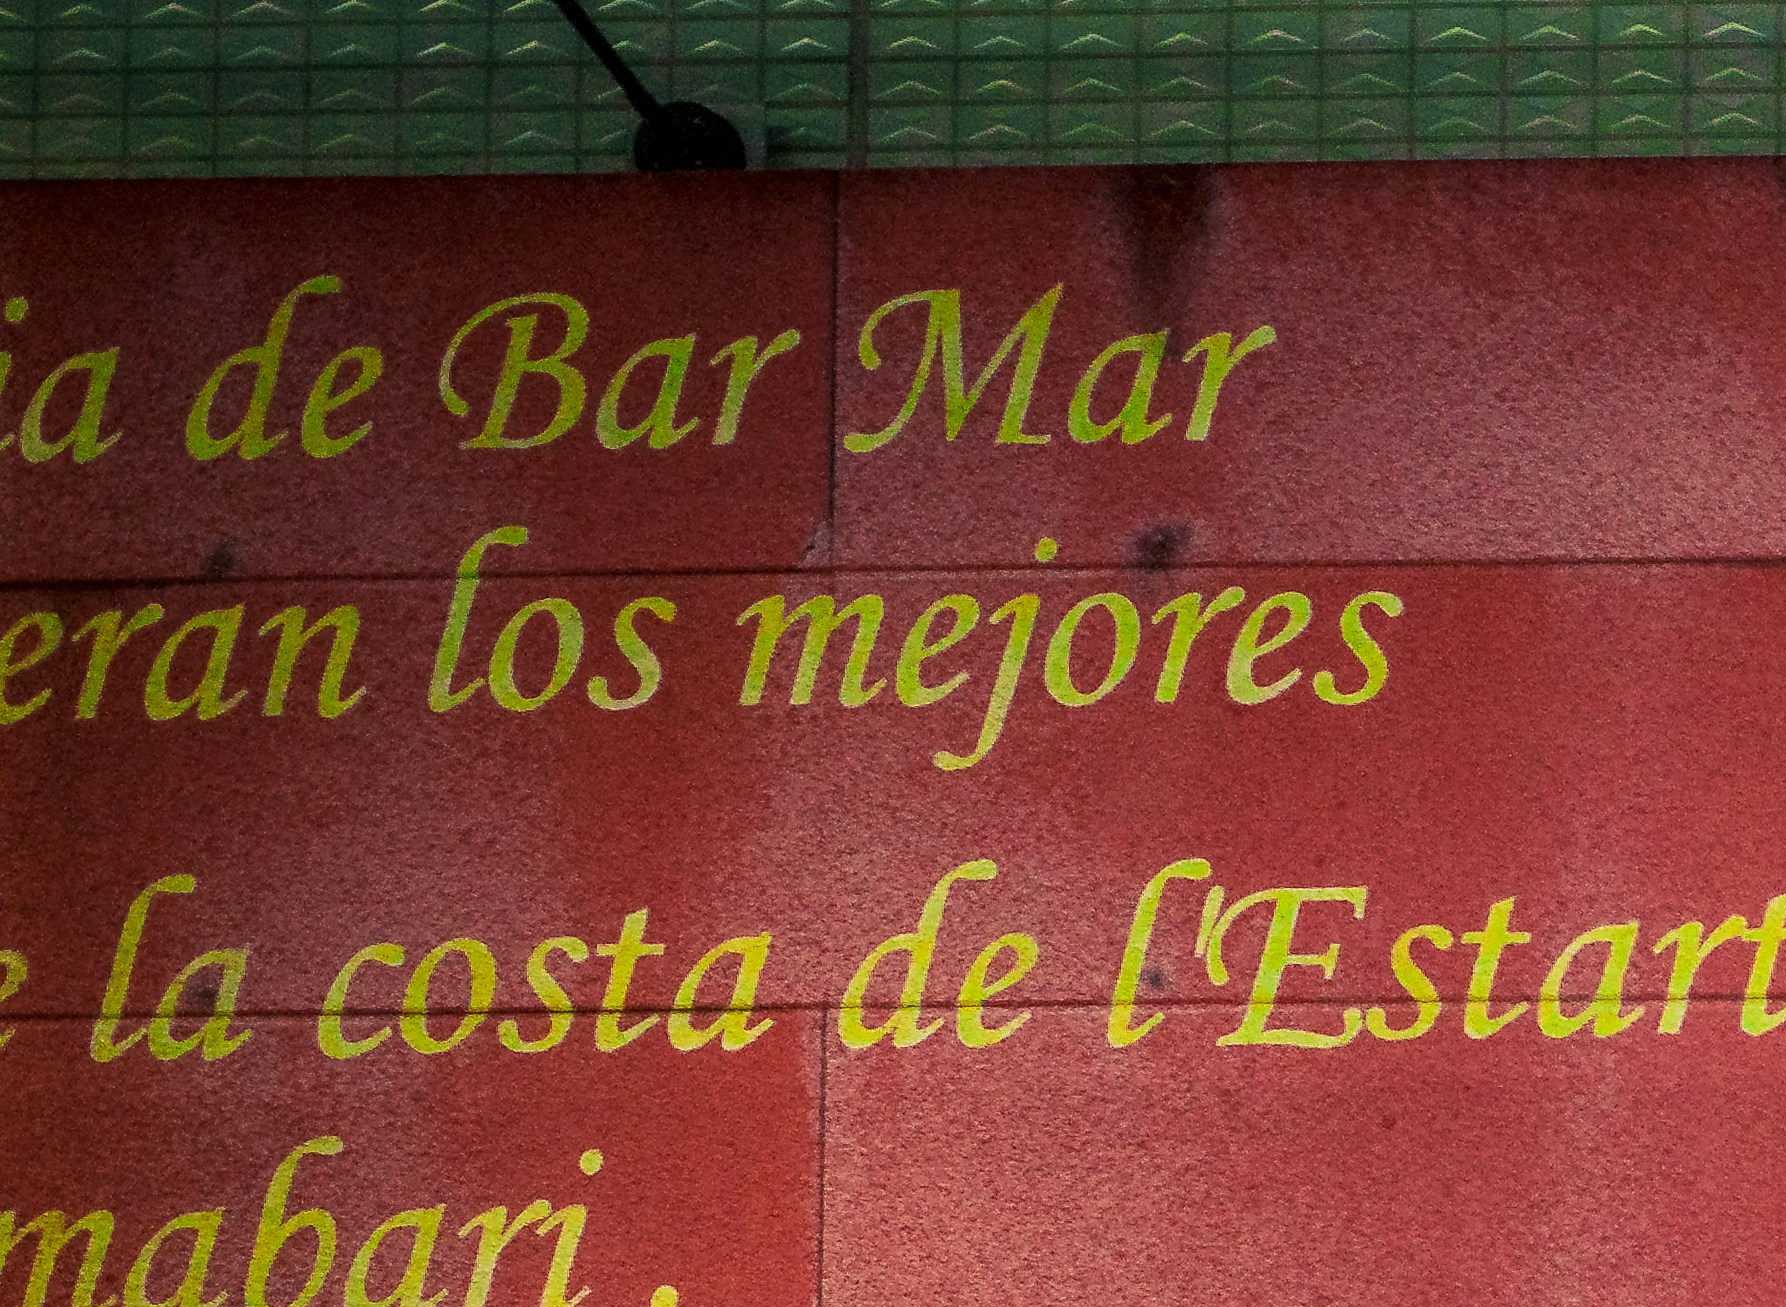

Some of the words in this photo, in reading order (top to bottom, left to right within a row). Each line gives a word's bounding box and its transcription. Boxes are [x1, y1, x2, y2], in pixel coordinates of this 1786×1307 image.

[183, 275, 384, 463] de
[438, 290, 802, 451] Bar
[841, 283, 1278, 455] Mar
[0, 602, 365, 727] eran
[426, 524, 678, 714] los
[735, 536, 1404, 773] mejores
[90, 872, 255, 1065] la
[315, 907, 775, 1062] costa
[835, 857, 1042, 1052] de
